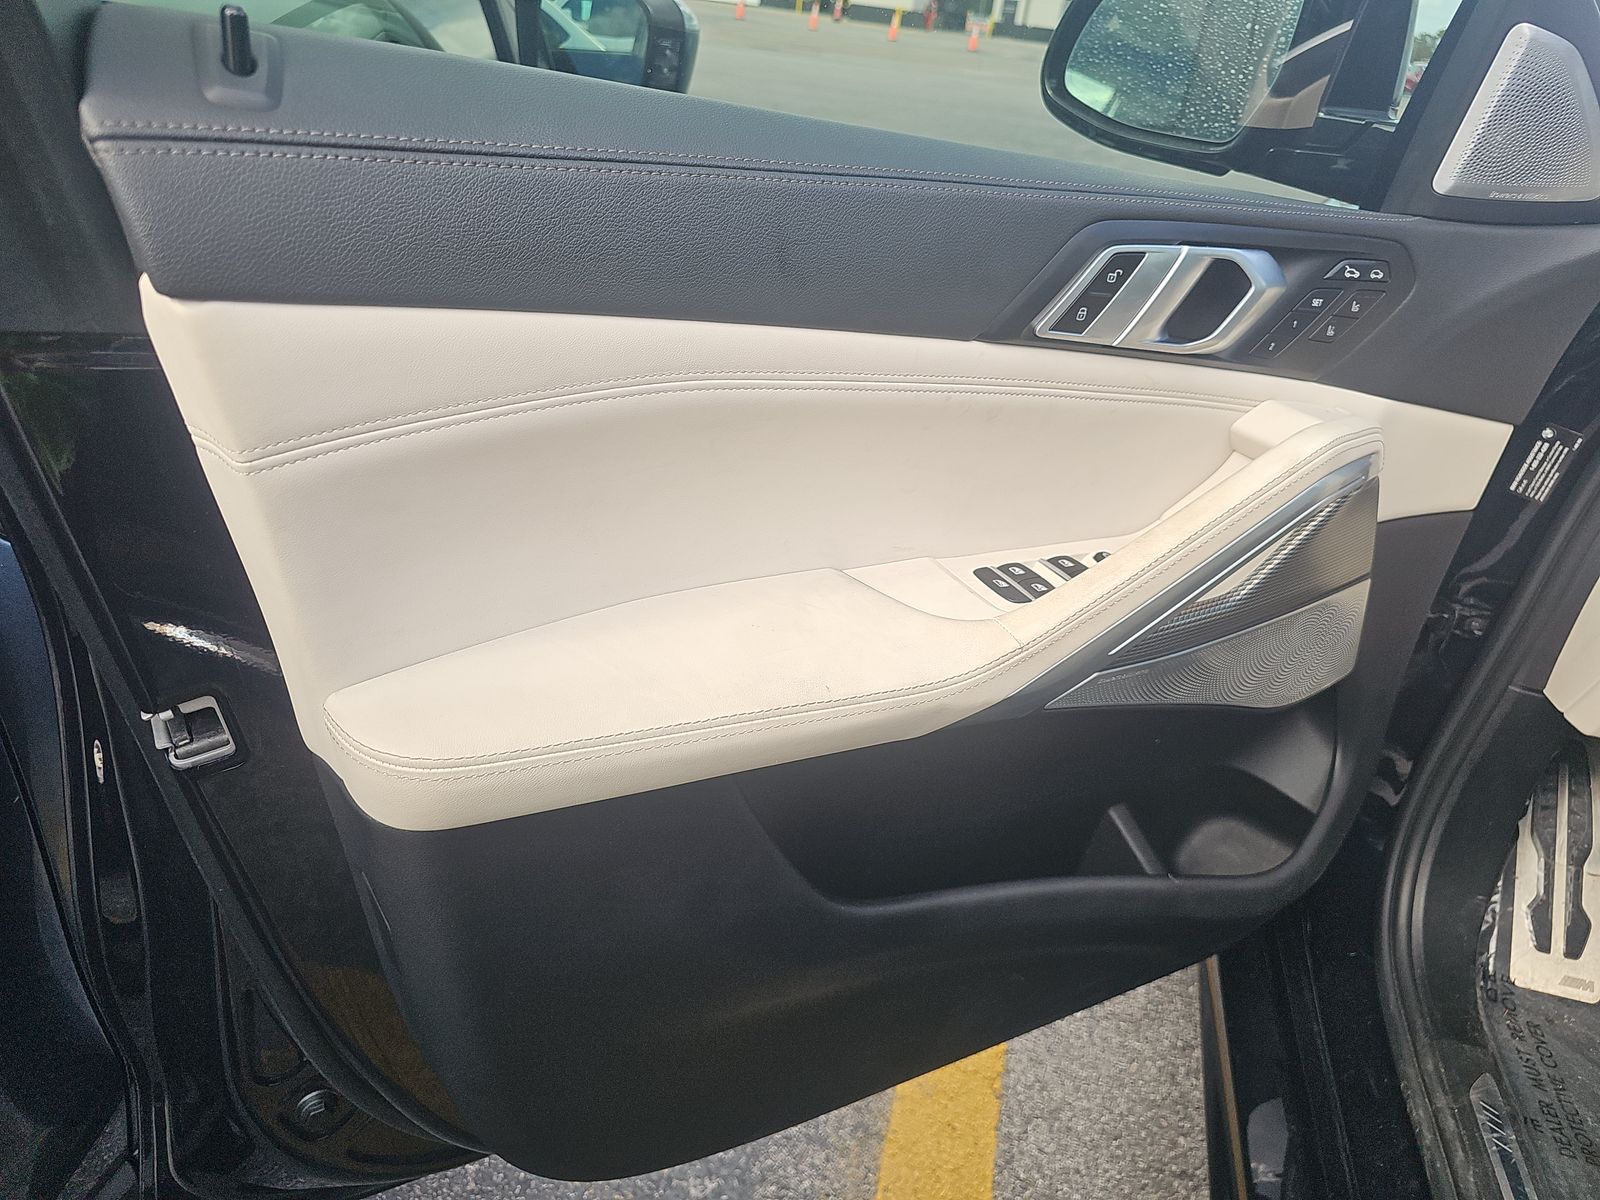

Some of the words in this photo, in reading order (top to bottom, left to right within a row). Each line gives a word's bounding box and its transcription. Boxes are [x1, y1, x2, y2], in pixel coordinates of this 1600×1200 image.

[1292, 320, 1298, 329] 1
[1311, 298, 1324, 307] SET
[1268, 342, 1276, 351] 2
[1501, 974, 1527, 1042] REMOVE
[1526, 1021, 1558, 1068] COVER
[1515, 1046, 1548, 1093] MUST
[1538, 1100, 1578, 1160] DEALER
[1547, 1072, 1600, 1167] PROTECTIVE
